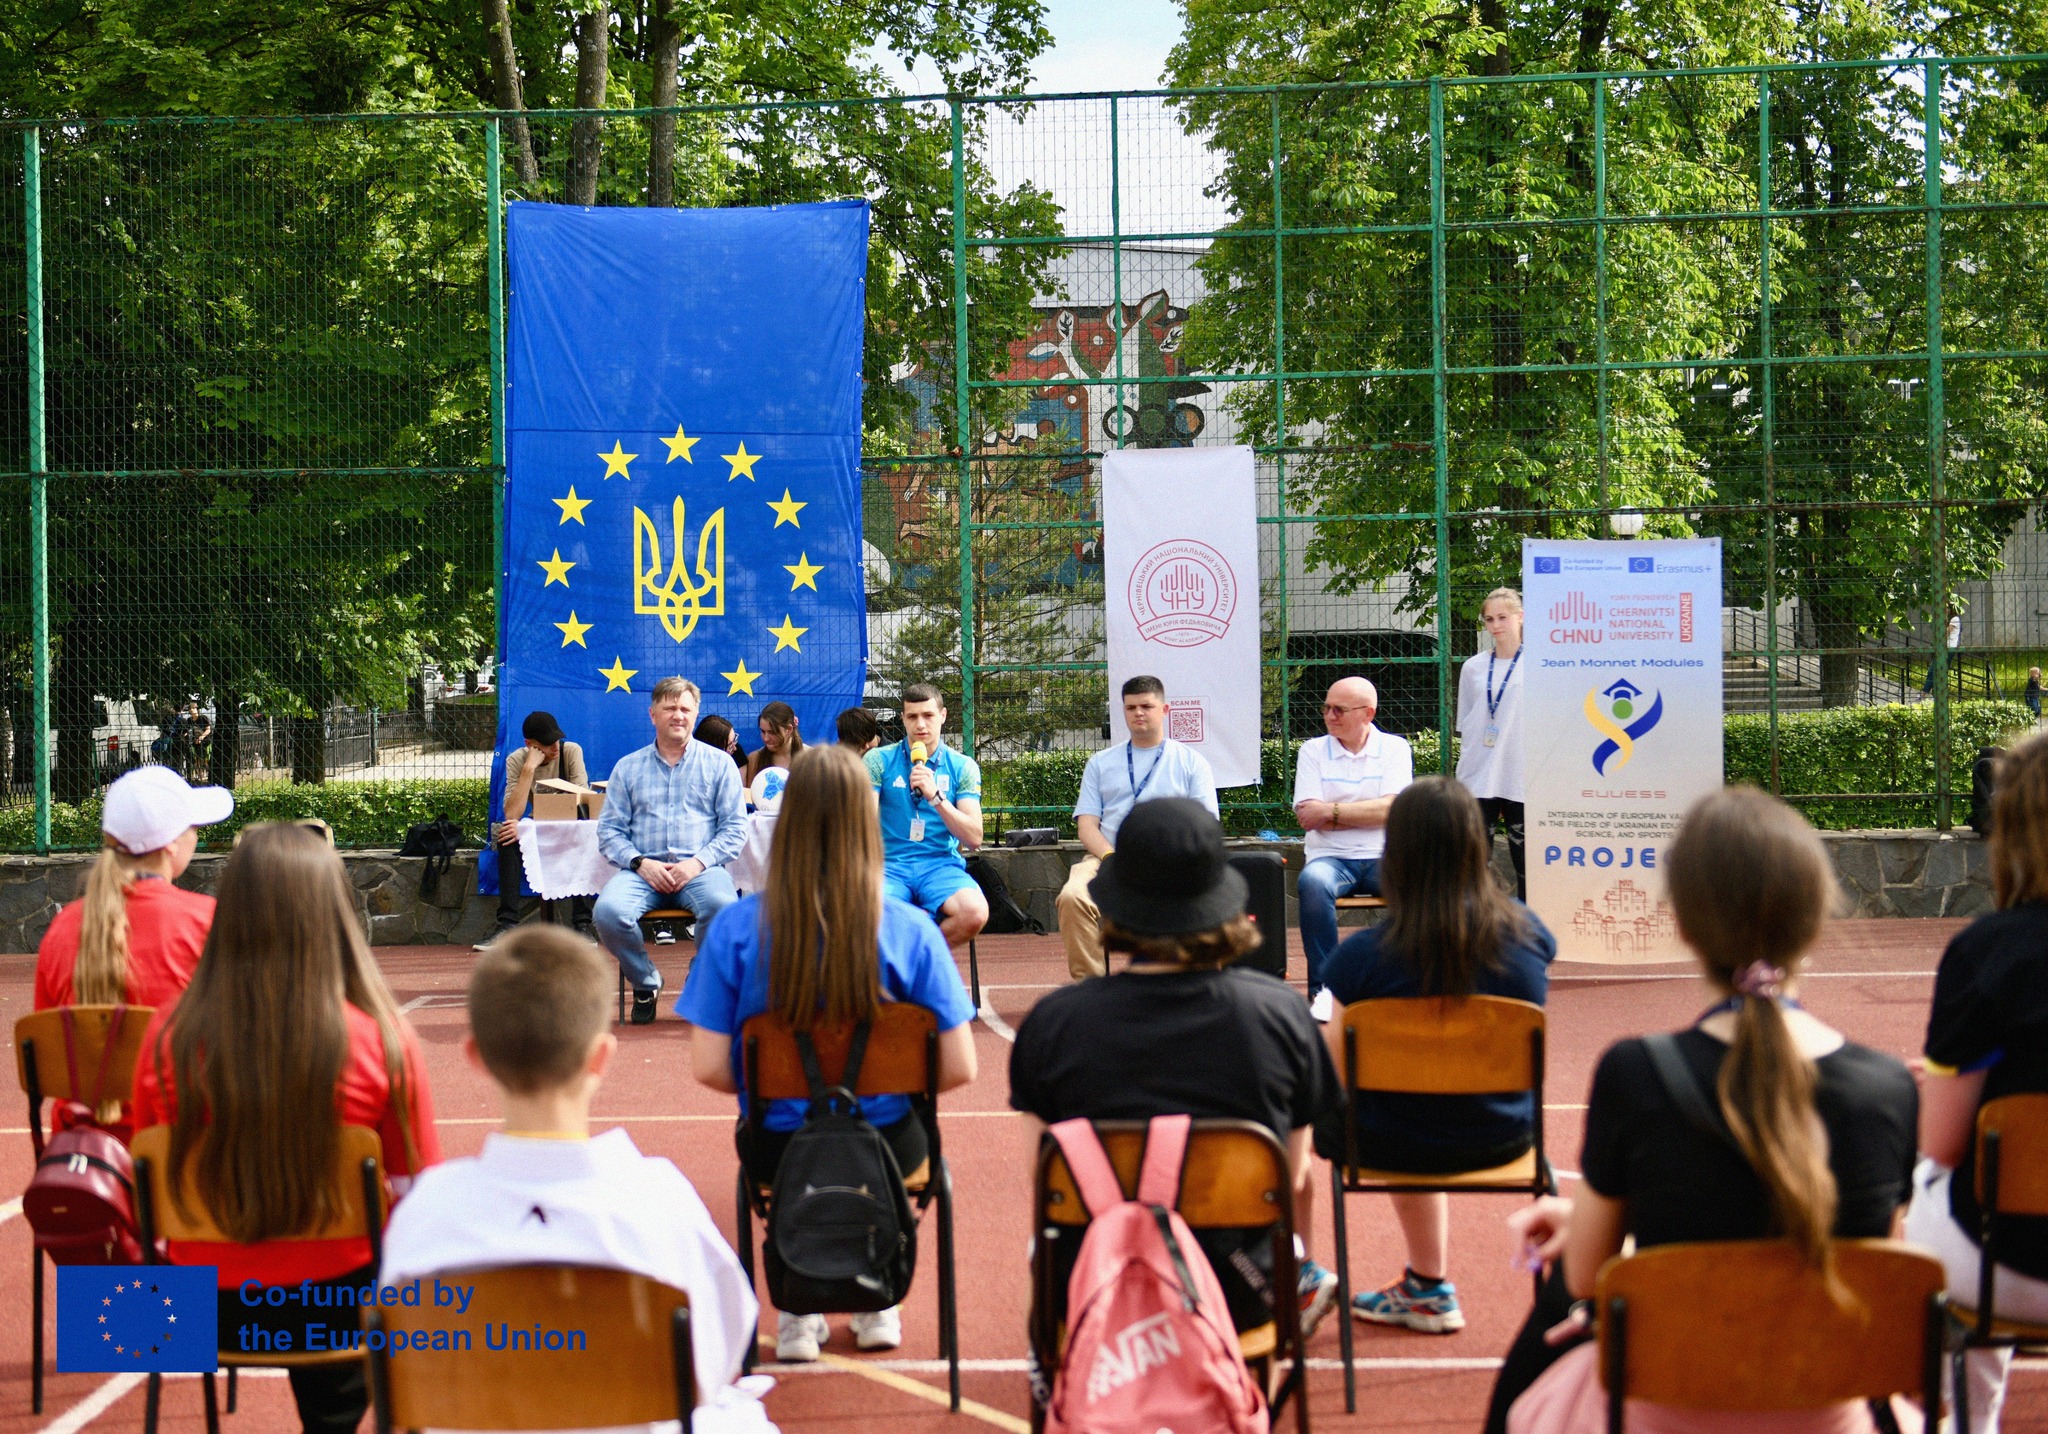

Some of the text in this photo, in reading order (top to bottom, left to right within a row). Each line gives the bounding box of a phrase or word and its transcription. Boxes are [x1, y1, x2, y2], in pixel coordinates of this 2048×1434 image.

[1656, 563, 1712, 574] Erasmus+
[1154, 546, 1215, 564] НАЦІОНАЛЬНИЙ
[1213, 562, 1230, 613] УНІВЕРСИТЕТ
[1160, 590, 1205, 610] ЧНУ
[1609, 608, 1675, 617] CHERNIVTSI
[1680, 594, 1692, 641] UKRAINE
[1609, 619, 1666, 628] NATIONAL
[1550, 629, 1603, 644] CHNU
[1609, 631, 1674, 640] UNIVERSITY
[1541, 658, 1704, 667] Jean Monnet Modules
[1547, 811, 1604, 819] INTEGRATION
[1620, 812, 1667, 820] EUROPEAN
[1549, 820, 1565, 828] THE
[1567, 821, 1597, 829] FIELDS
[1598, 821, 1611, 829] OF
[1575, 830, 1615, 838] SCIENCE,
[1544, 845, 1664, 869] PROJE
